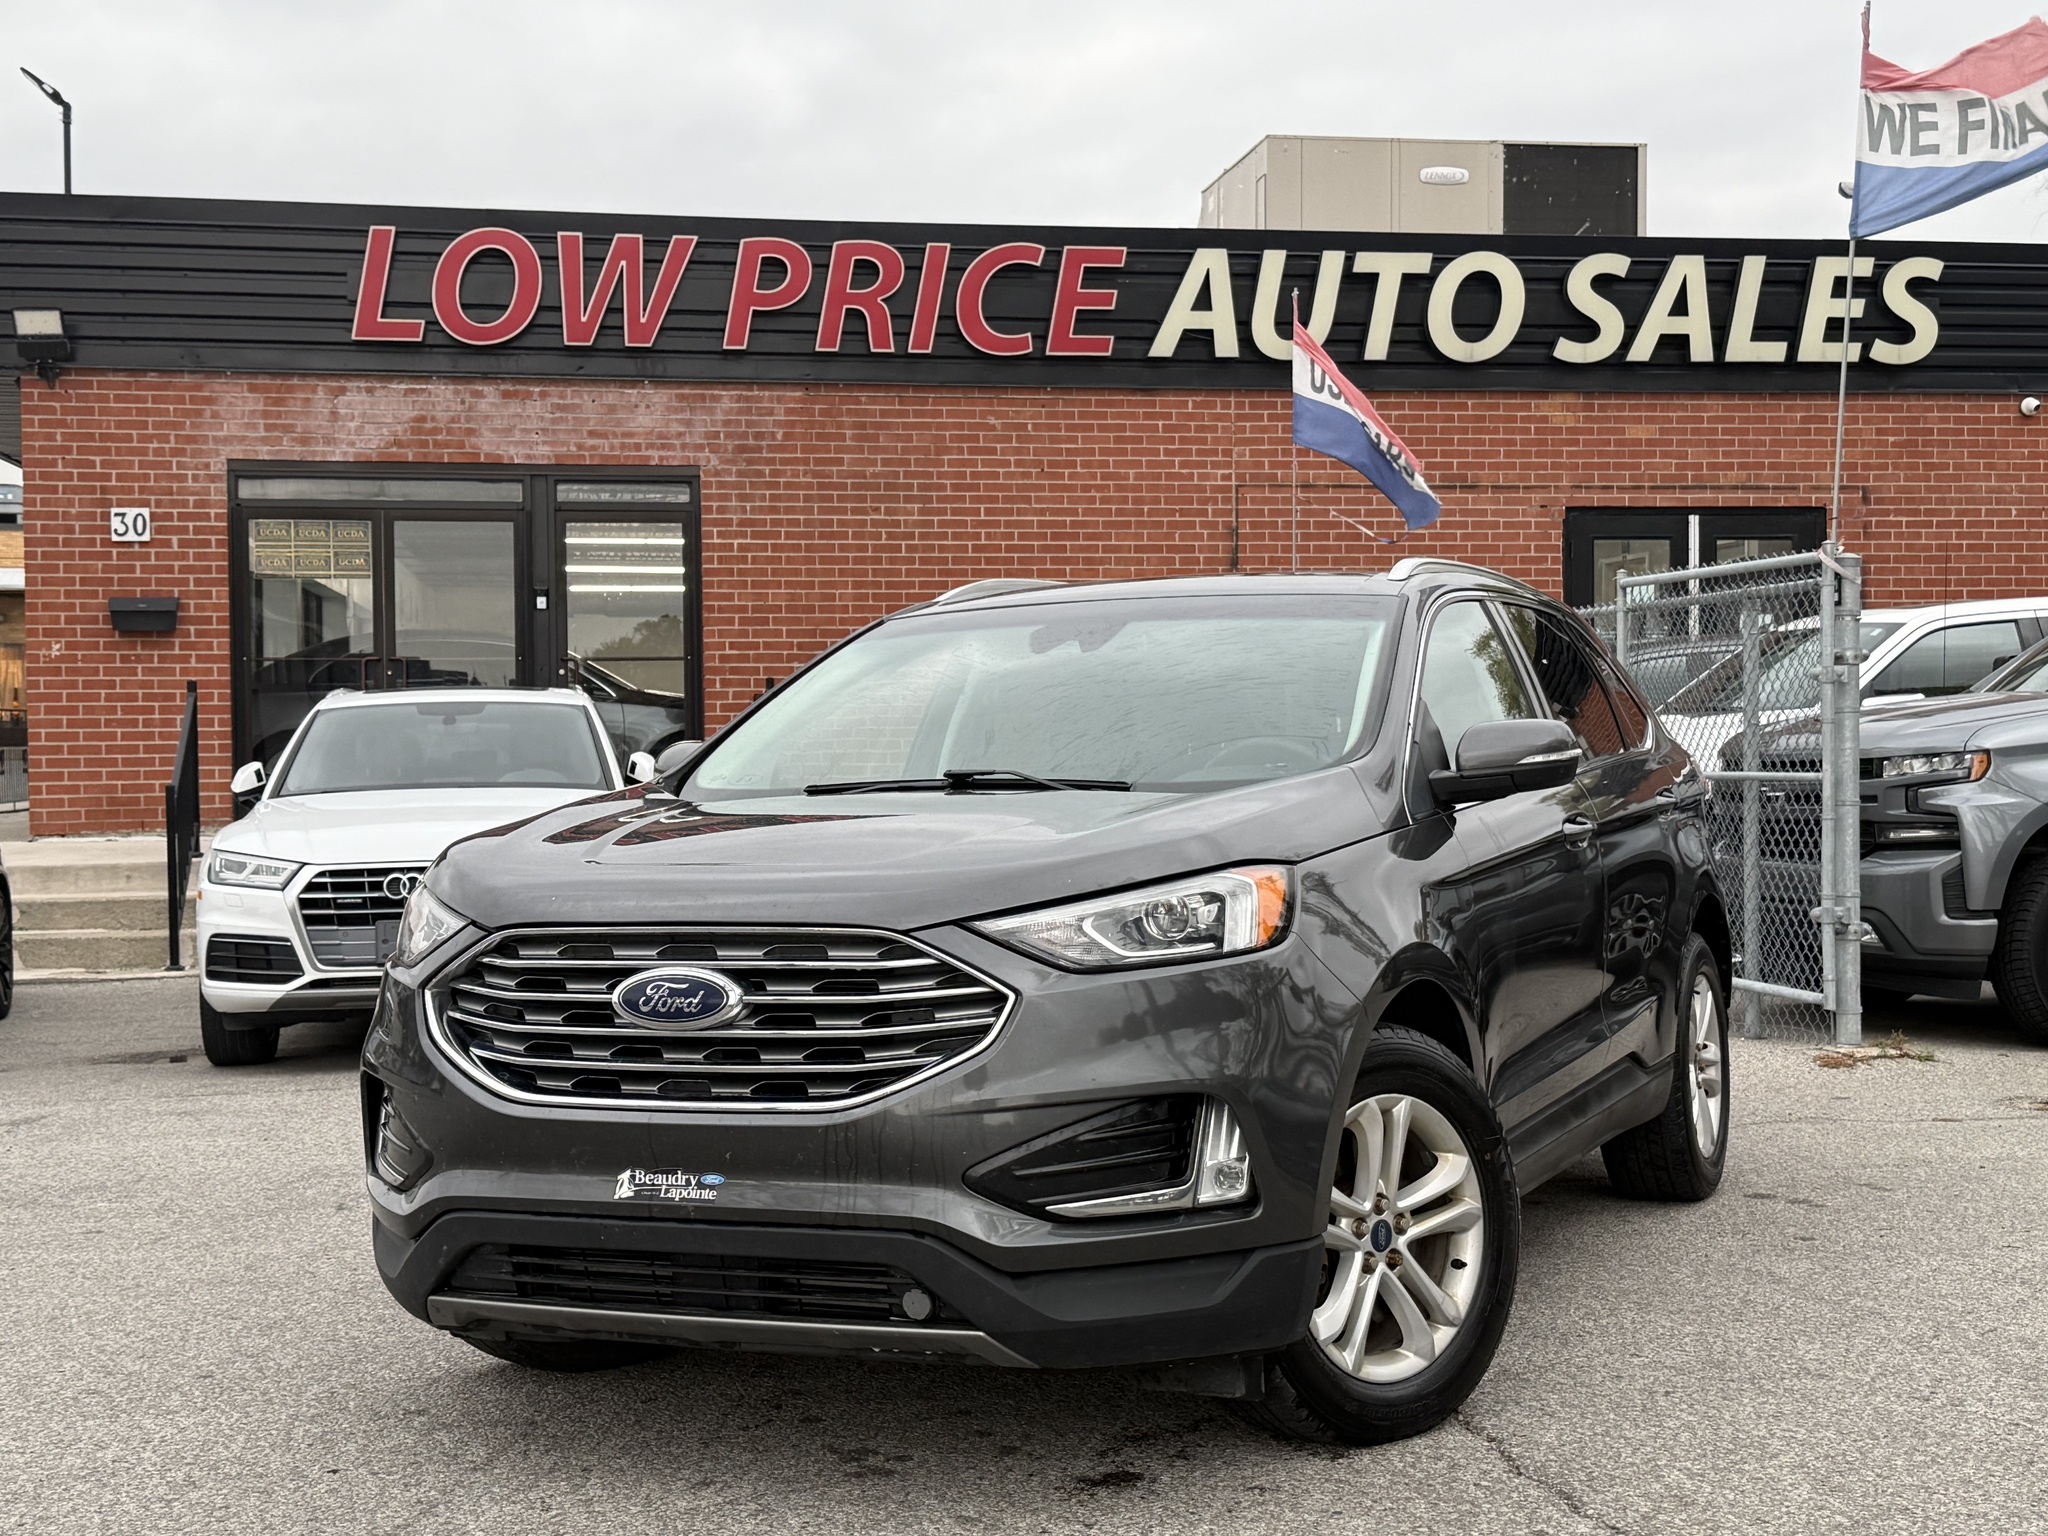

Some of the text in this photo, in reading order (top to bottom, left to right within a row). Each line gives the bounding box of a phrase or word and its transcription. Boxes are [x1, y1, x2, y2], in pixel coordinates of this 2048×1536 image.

[1864, 90, 2048, 156] WE FINA
[1424, 171, 1458, 180] LENNOX
[351, 225, 1945, 365] LOW PRICE AUTO SALES
[113, 512, 147, 537] 30
[259, 528, 288, 537] UCDA
[298, 528, 326, 538] UCDA
[337, 529, 365, 538] UCDA
[260, 559, 288, 567] UCDA
[299, 559, 327, 567] UCDA
[638, 981, 705, 1013] Ford
[634, 1169, 700, 1189] Beaudry
[660, 1184, 718, 1201] Lapointe
